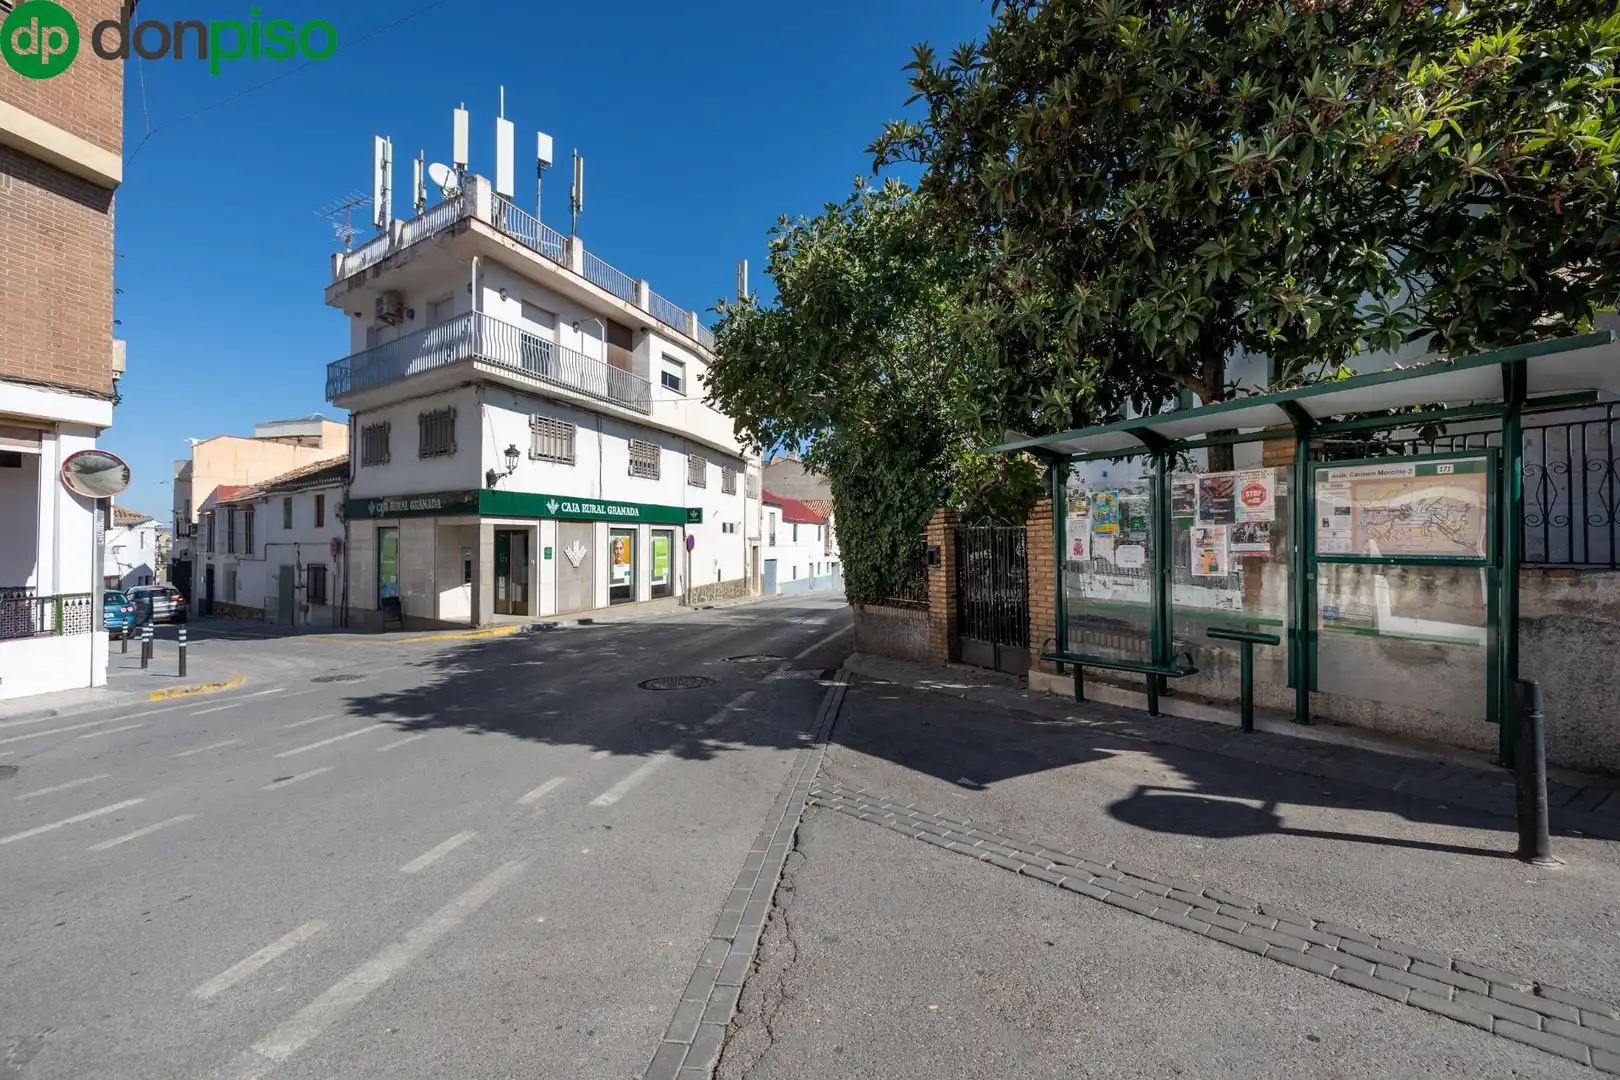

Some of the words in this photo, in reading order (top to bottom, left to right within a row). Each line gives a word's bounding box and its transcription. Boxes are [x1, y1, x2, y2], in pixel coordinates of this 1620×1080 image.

[1245, 490, 1262, 498] STOP
[409, 498, 442, 511] GRANADA
[561, 502, 580, 513] CAJA
[581, 503, 607, 515] RURAL
[607, 505, 640, 517] GRANADA
